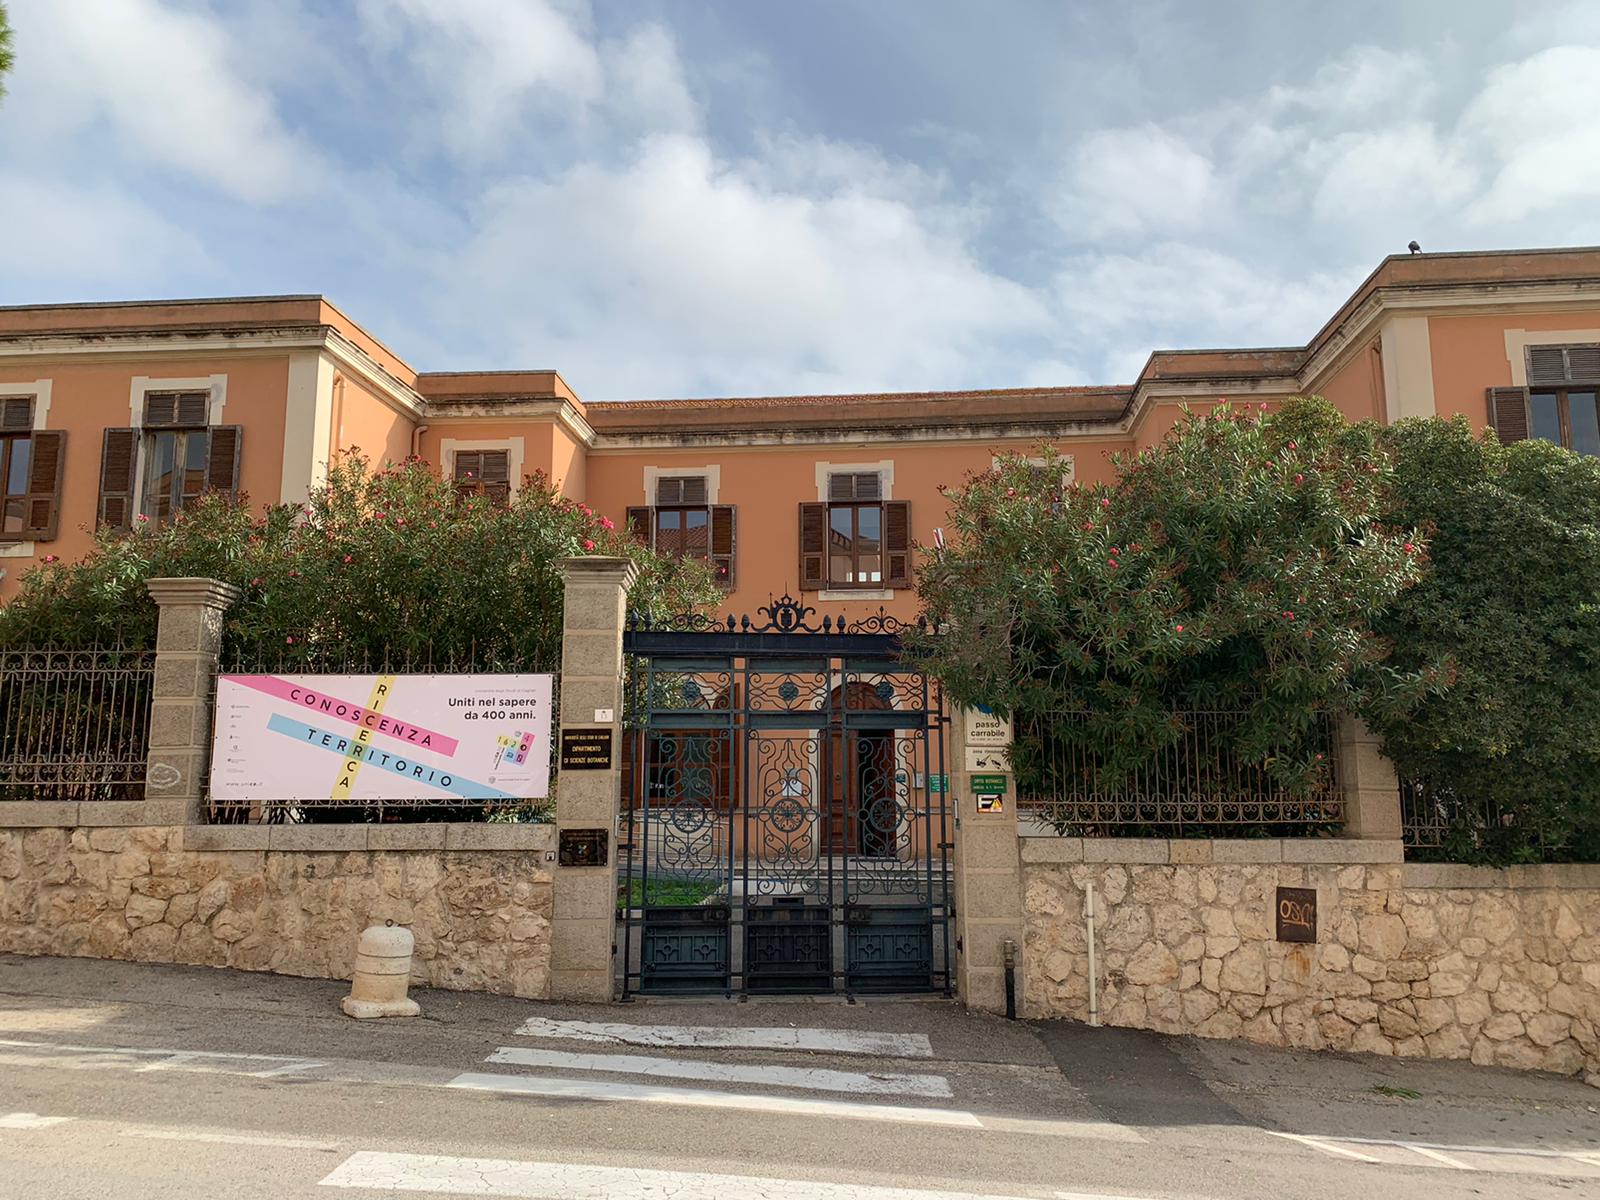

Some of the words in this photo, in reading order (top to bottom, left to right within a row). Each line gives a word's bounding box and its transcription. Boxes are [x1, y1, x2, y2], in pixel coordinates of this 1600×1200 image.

[290, 688, 432, 747] CONOSCENZA
[448, 697, 475, 707] Uniti
[478, 697, 495, 707] nel
[499, 698, 537, 708] sapere
[464, 711, 479, 720] da
[481, 710, 506, 720] 400
[509, 710, 536, 720] anni.
[339, 684, 388, 788] RICERCA
[970, 729, 1005, 738] carrabile
[307, 728, 452, 787] TERRITORIO
